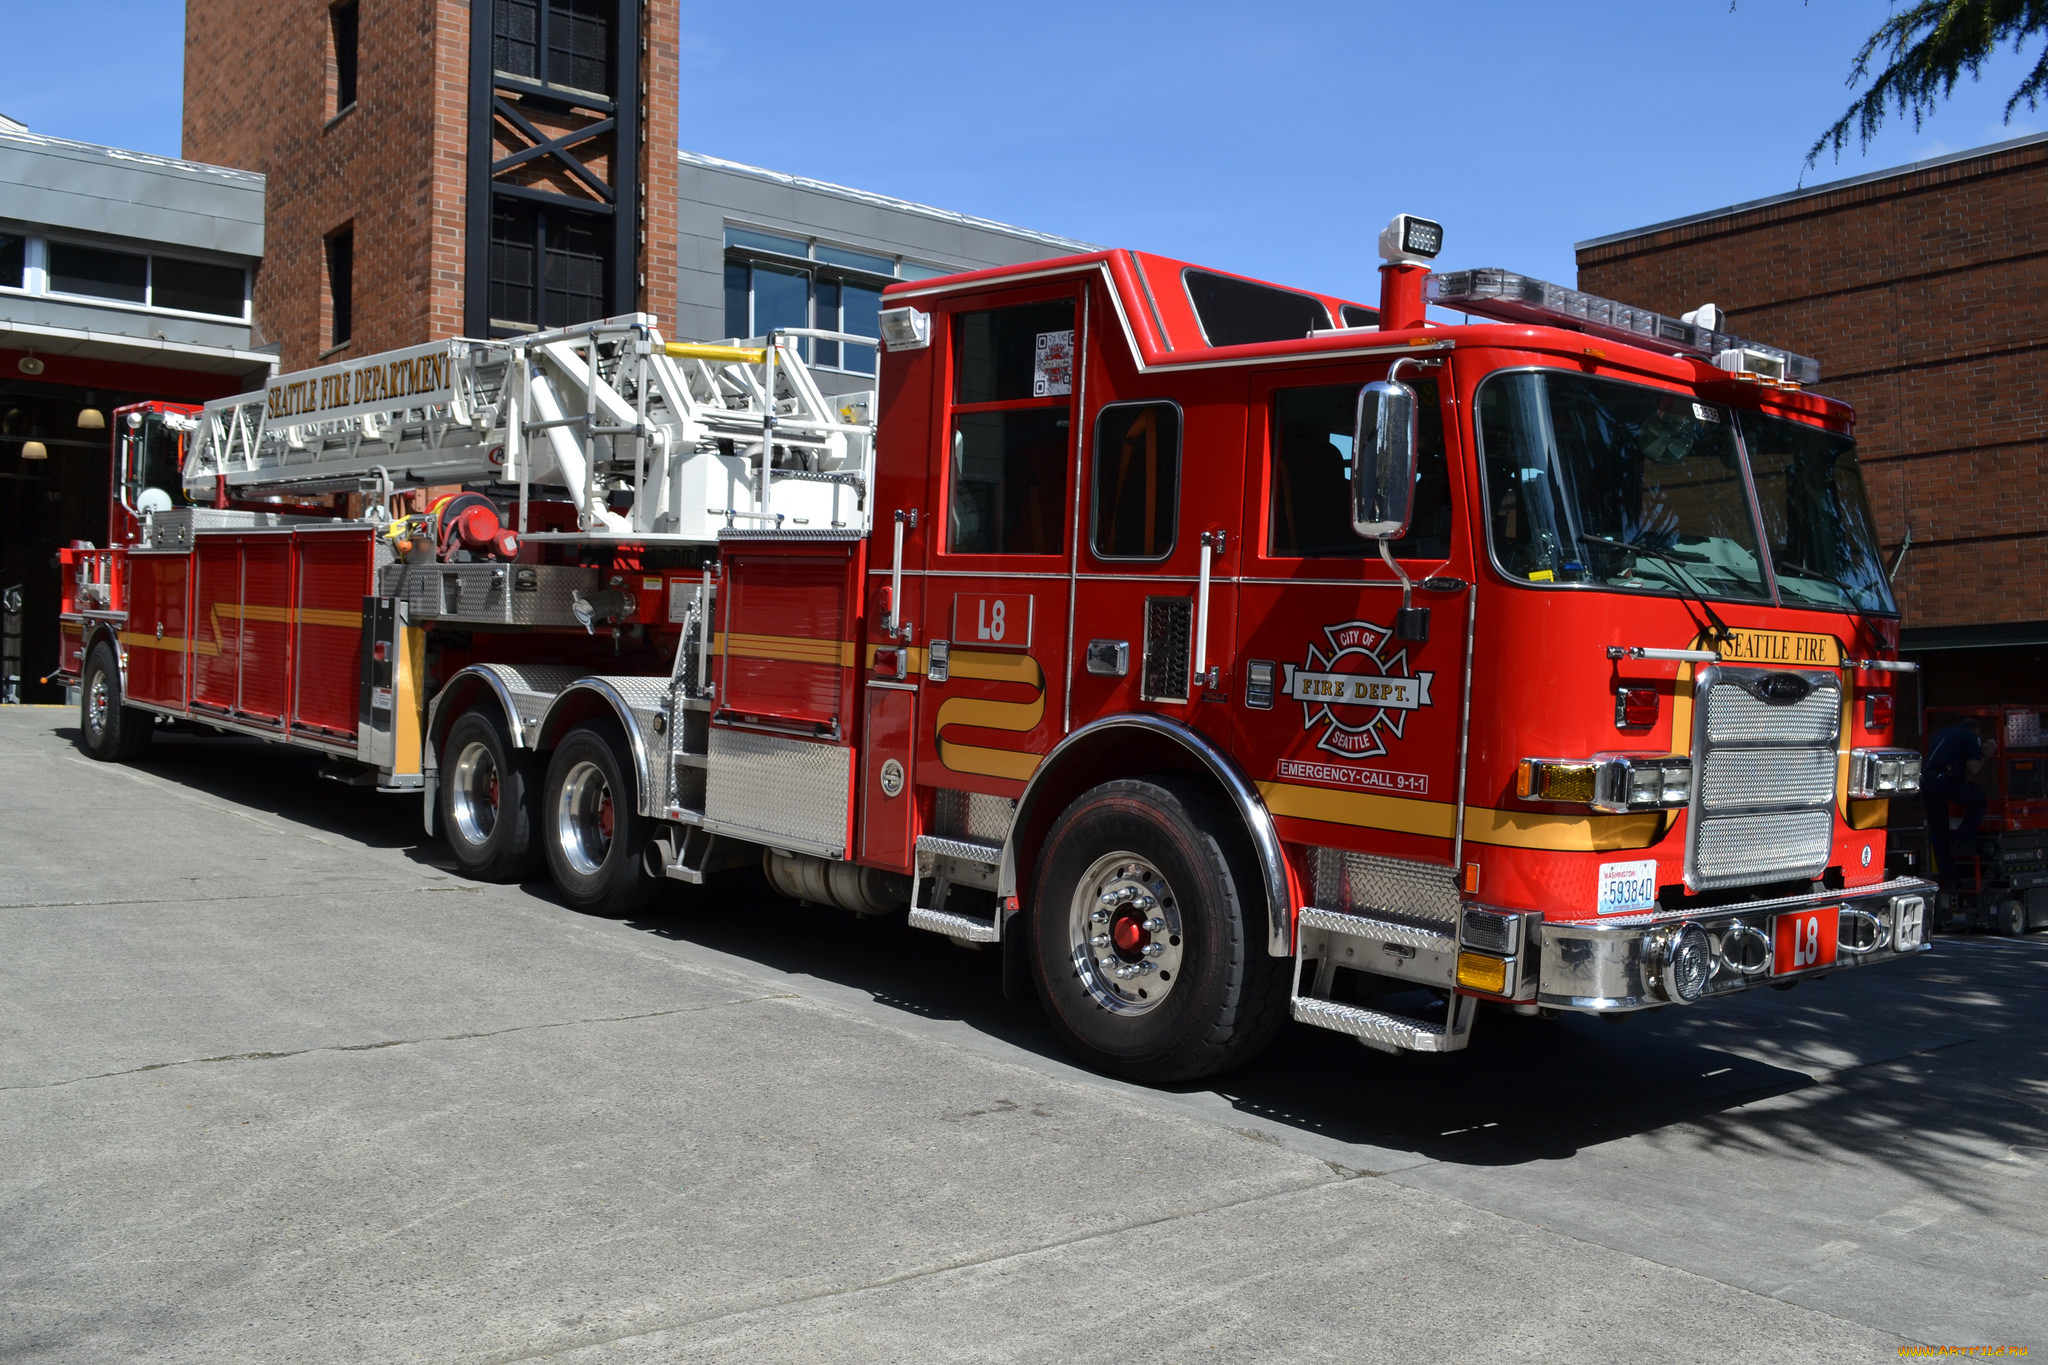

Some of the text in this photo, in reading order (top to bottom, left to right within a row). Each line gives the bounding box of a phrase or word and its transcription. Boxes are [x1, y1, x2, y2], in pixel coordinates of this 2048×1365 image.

[268, 351, 451, 419] SEATTLE FIRE DEPARTMENT
[977, 599, 1006, 641] L8
[1340, 630, 1376, 646] CITY OF
[1724, 632, 1827, 662] SEATTLE FIRE
[1302, 678, 1410, 702] FIRE DEPT.
[1332, 731, 1371, 750] SEATTLE
[1397, 775, 1425, 791] 9-1-1
[1604, 870, 1636, 879] WASHINGTON
[1793, 916, 1819, 967] L8
